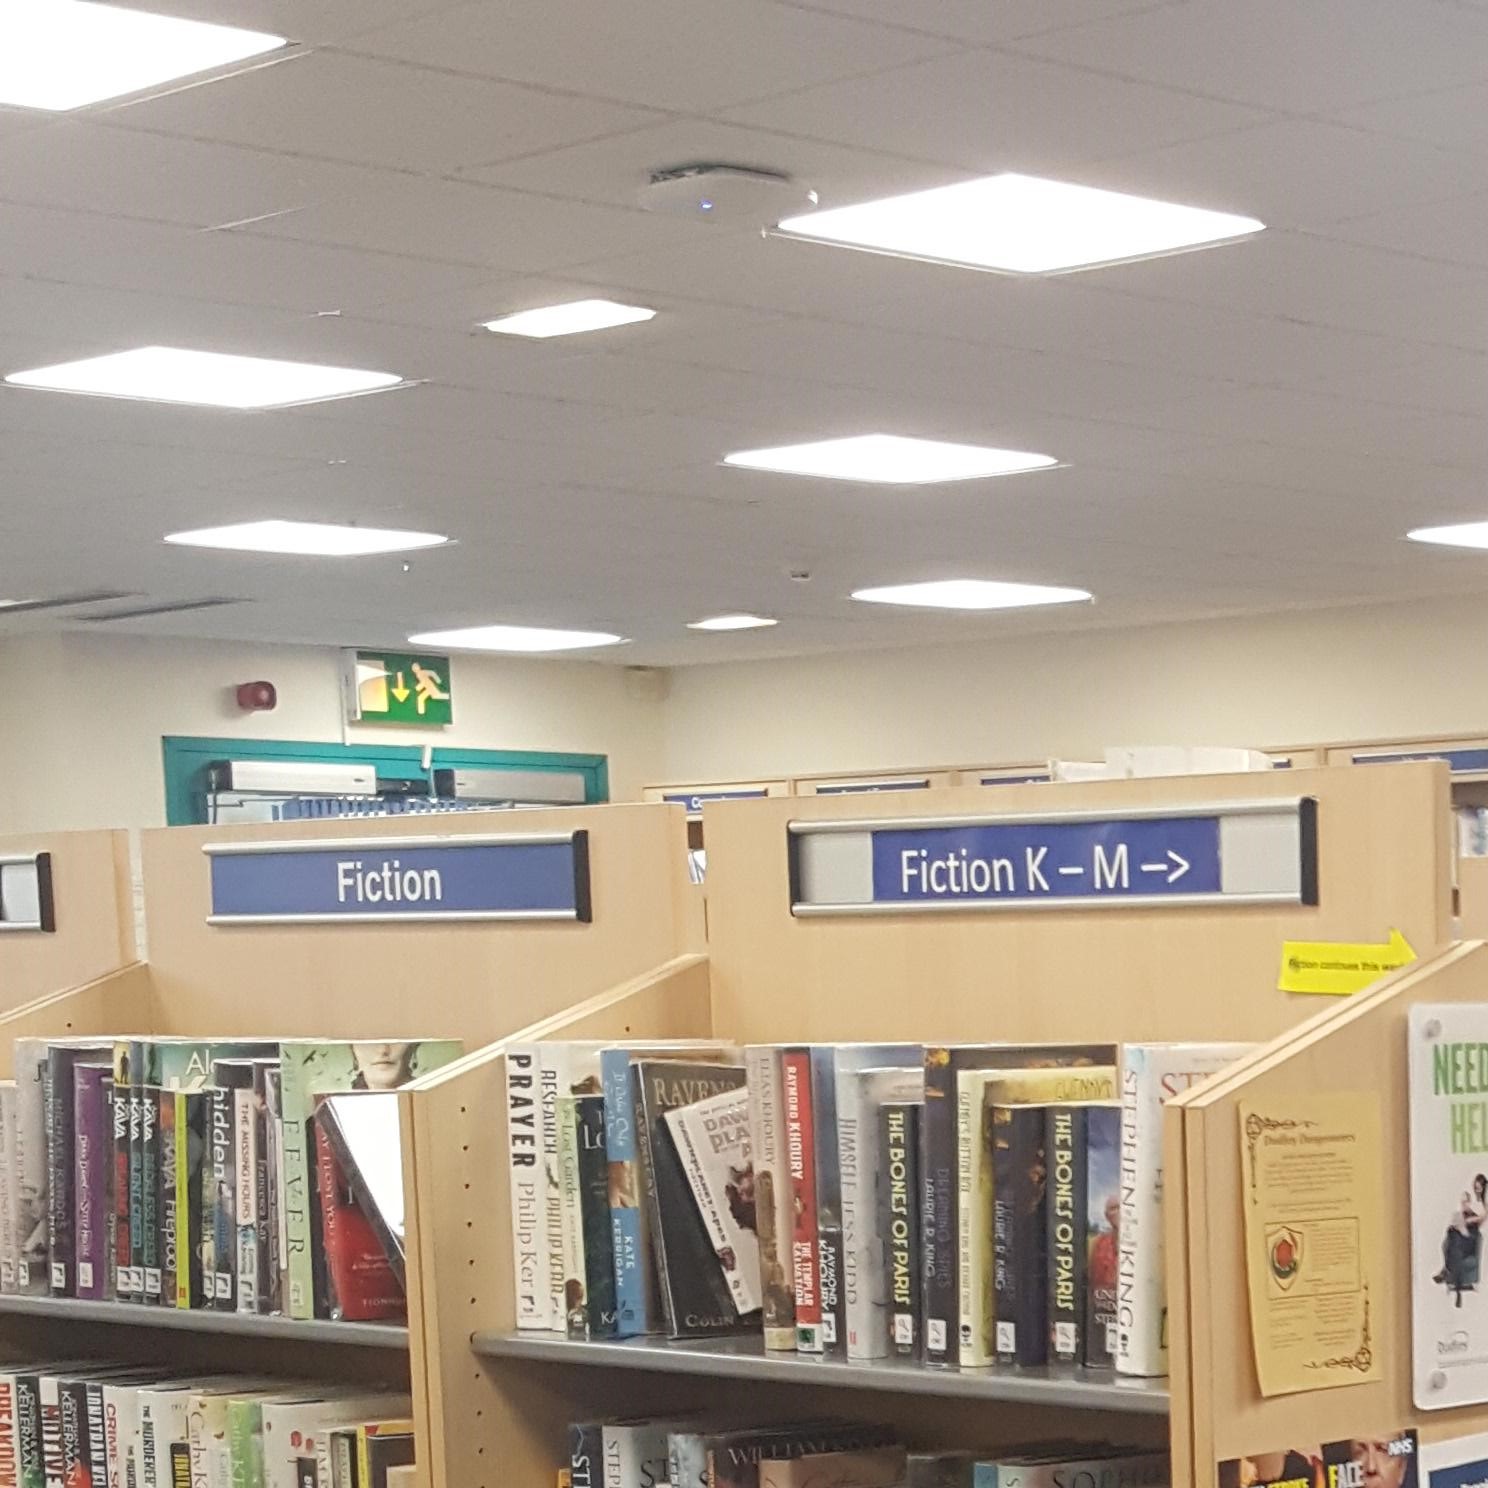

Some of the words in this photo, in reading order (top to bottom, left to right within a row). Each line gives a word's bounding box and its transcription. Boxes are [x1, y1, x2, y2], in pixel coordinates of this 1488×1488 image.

[337, 860, 442, 902] Fiction
[900, 849, 1013, 895] Fiction
[1025, 846, 1049, 891] K
[1093, 843, 1129, 890] M
[240, 1103, 250, 1127] THE
[508, 1054, 537, 1168] PRAYER
[786, 1065, 799, 1119] RAYMOND
[212, 1086, 230, 1180] hidden
[241, 1130, 252, 1178] MISSING
[788, 1120, 803, 1180] KHOURY
[887, 1113, 905, 1147] THE
[1055, 1113, 1073, 1147] THE
[1121, 1069, 1139, 1208] STEPHEN
[241, 1179, 252, 1220] HOURS
[888, 1148, 906, 1216] BONES
[1054, 1149, 1073, 1216] BONES
[892, 1222, 909, 1248] OF
[1056, 1223, 1073, 1253] OF
[892, 1250, 911, 1306] PARIS
[1056, 1254, 1074, 1311] PARIS
[1119, 1249, 1137, 1330] KING
[106, 1402, 119, 1468] CRIME
[1387, 1438, 1414, 1457] NHS
